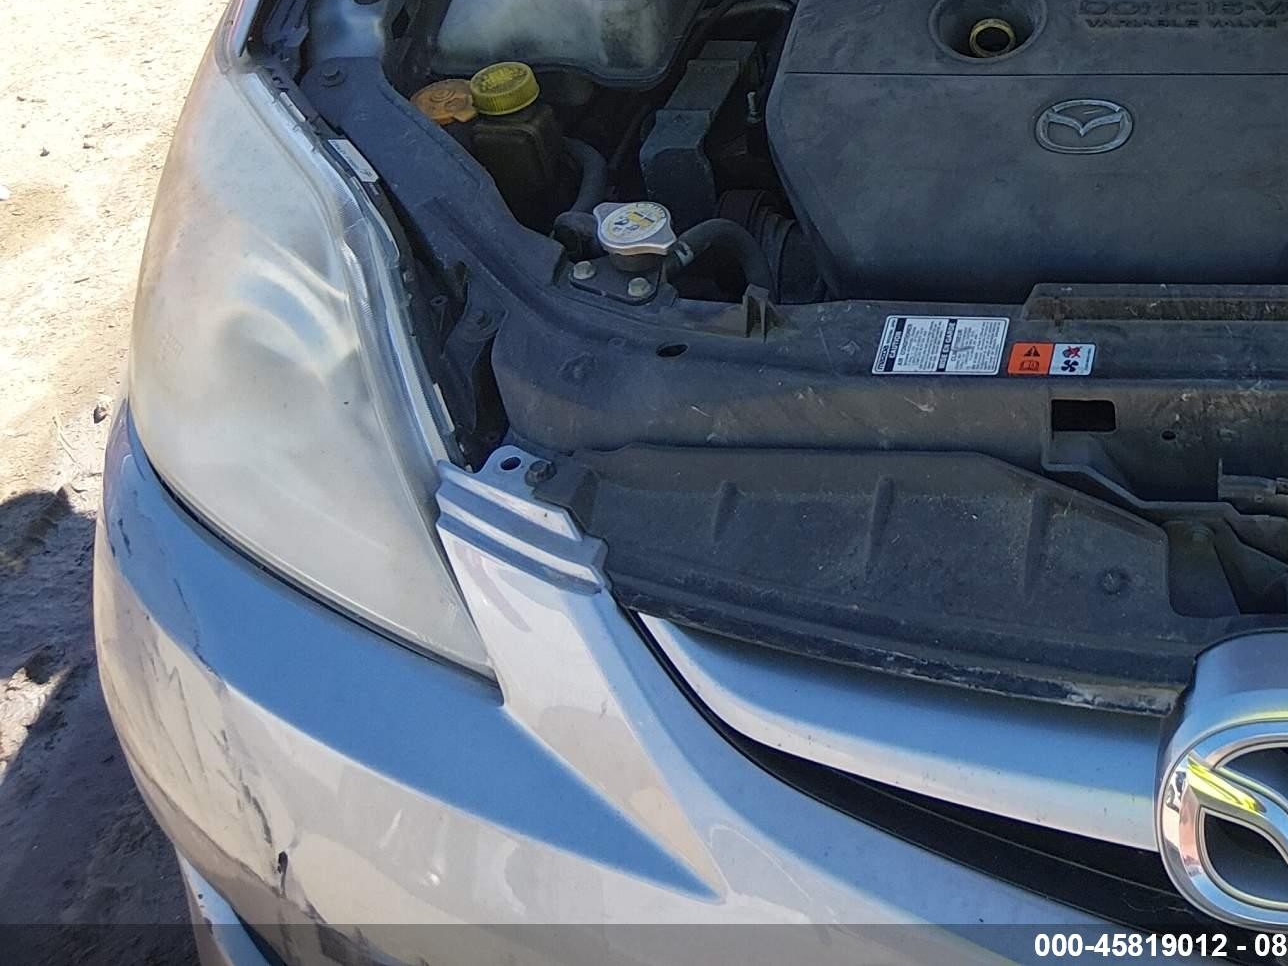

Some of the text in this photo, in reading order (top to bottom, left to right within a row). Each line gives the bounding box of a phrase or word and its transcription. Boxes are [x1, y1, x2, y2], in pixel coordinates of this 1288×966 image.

[1085, 19, 1199, 28] VARIABLE
[1209, 19, 1277, 28] VALVE
[889, 330, 902, 359] CAUTION
[897, 323, 912, 367] AIR CONDITIONER
[938, 322, 956, 370] MISE EN GARDE
